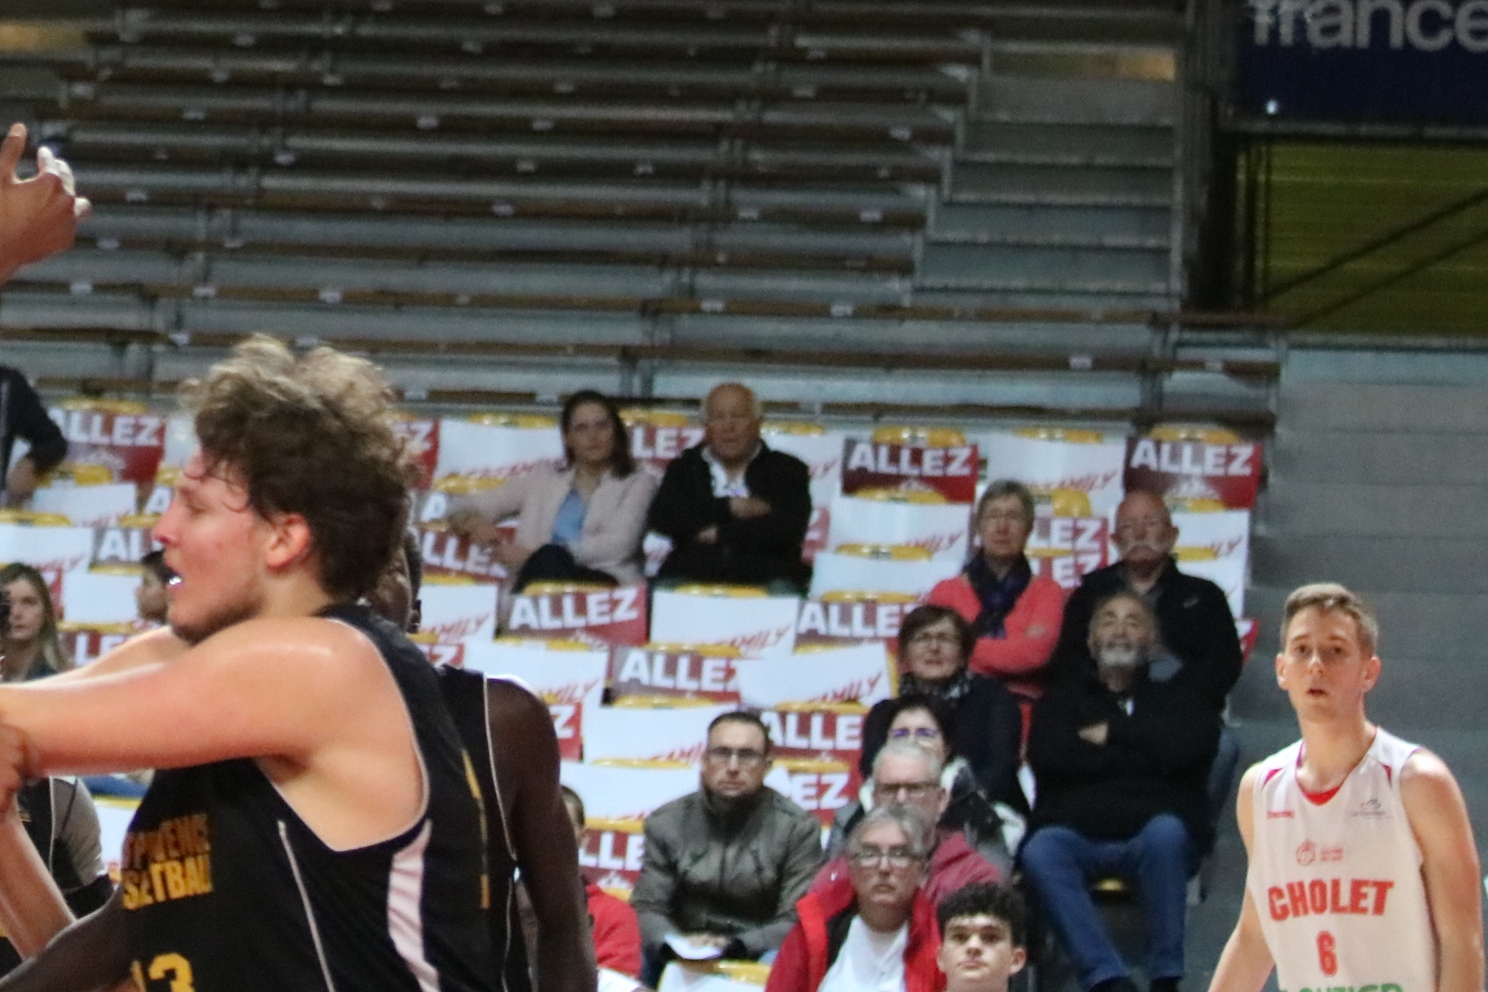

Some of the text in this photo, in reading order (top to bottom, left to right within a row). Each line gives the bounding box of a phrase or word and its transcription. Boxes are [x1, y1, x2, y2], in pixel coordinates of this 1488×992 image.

[631, 426, 707, 460] LEZ
[848, 443, 972, 477] ALLEZ
[1130, 438, 1255, 477] ALLEZ
[509, 588, 641, 631] ALLEZ
[797, 602, 914, 639] ALLE
[620, 649, 734, 692] ALLE
[1267, 878, 1394, 921] CHOLET
[1316, 931, 1338, 976] 6
